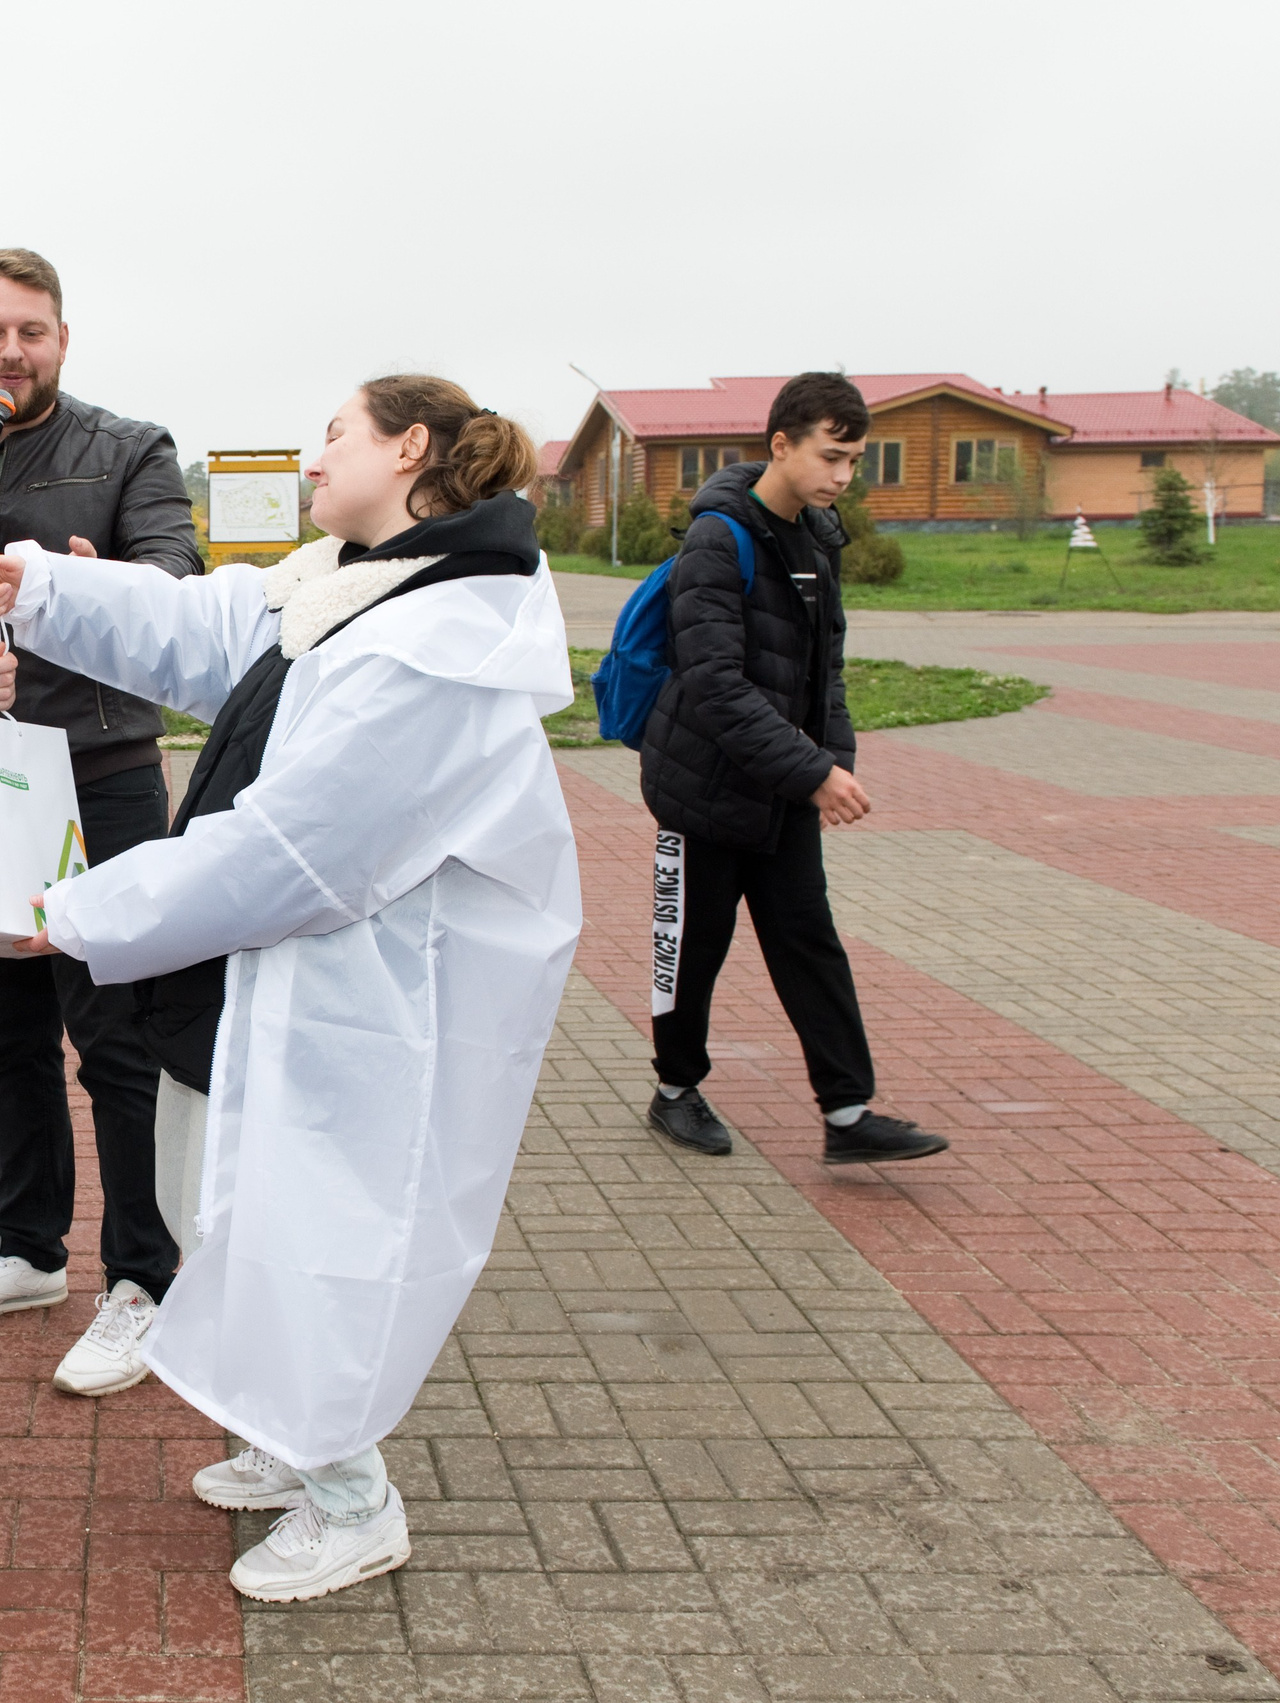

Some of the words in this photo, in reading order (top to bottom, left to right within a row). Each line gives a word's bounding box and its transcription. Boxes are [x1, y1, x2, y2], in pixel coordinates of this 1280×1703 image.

[656, 830, 682, 857] DS
[654, 863, 680, 924] DSTNCE
[653, 931, 677, 995] DSTNCE
